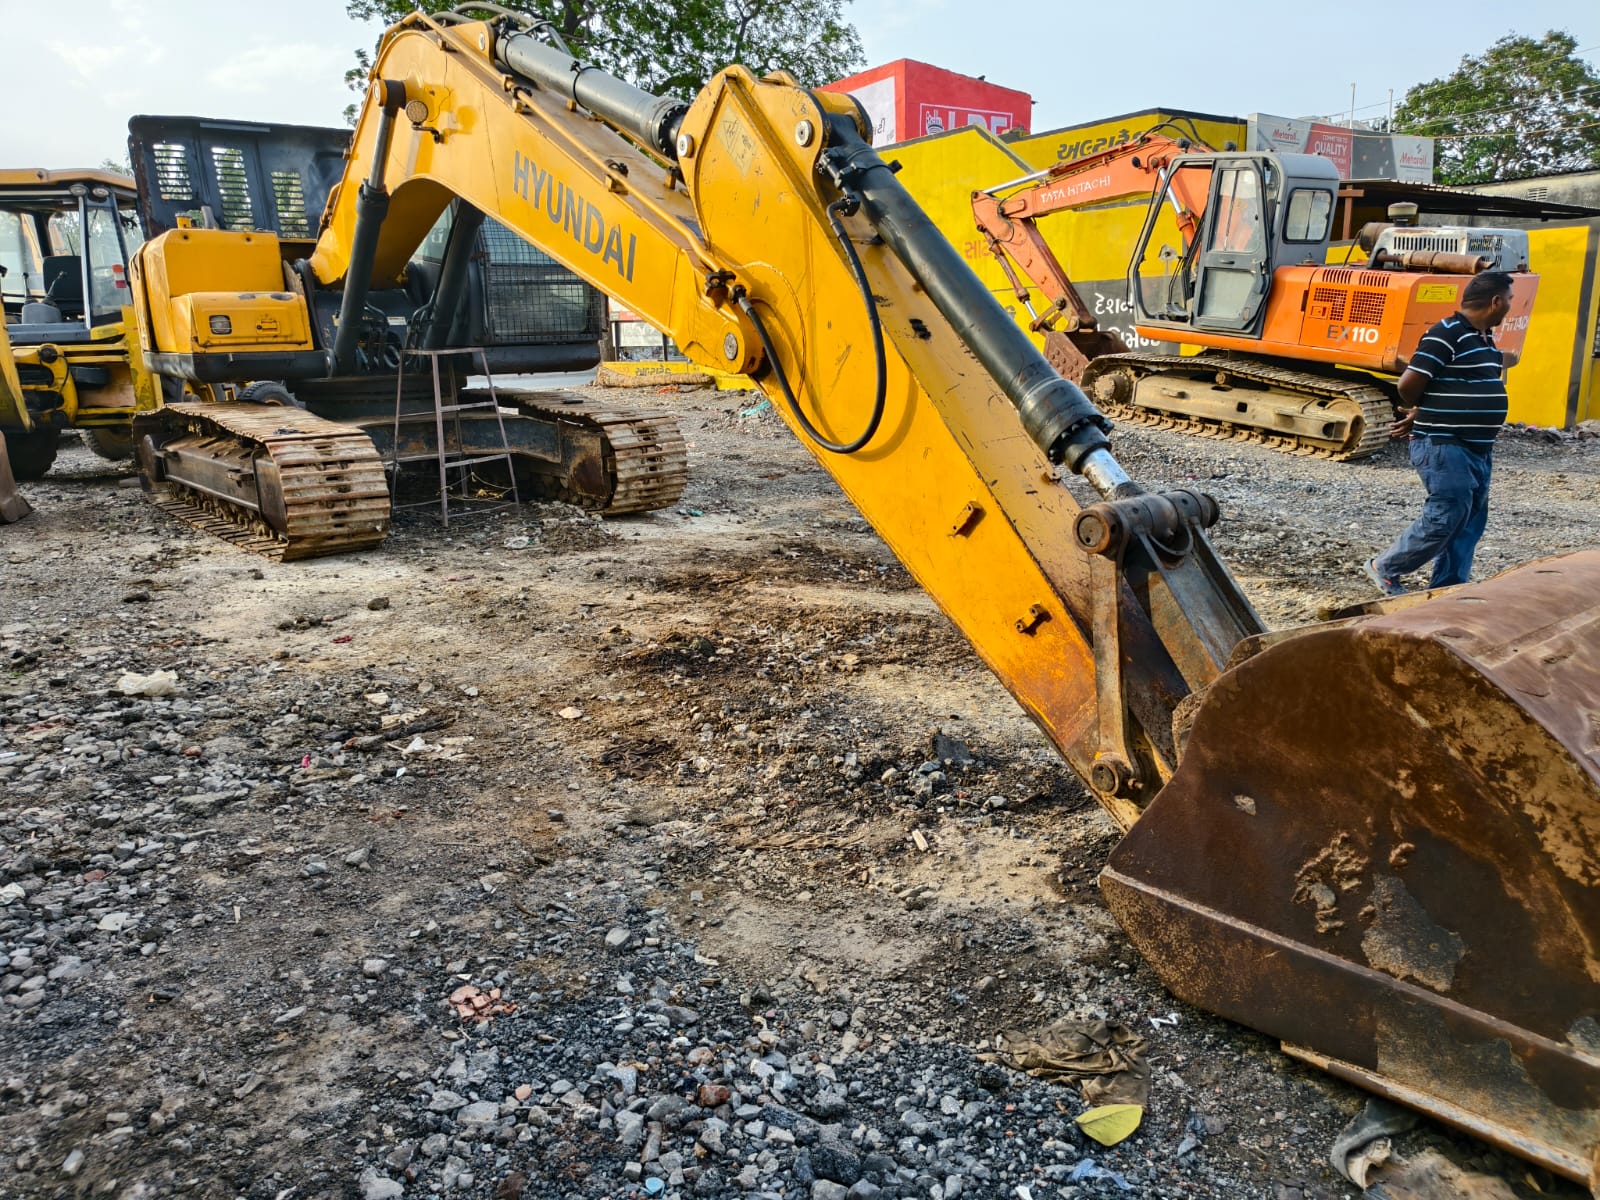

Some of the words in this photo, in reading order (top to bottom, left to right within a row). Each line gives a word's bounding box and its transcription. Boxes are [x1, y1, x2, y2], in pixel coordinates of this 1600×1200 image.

[1314, 140, 1348, 157] QUALITY
[1040, 189, 1065, 204] TATA
[1067, 175, 1111, 197] HITACHI
[513, 150, 637, 283] HYUNDAI
